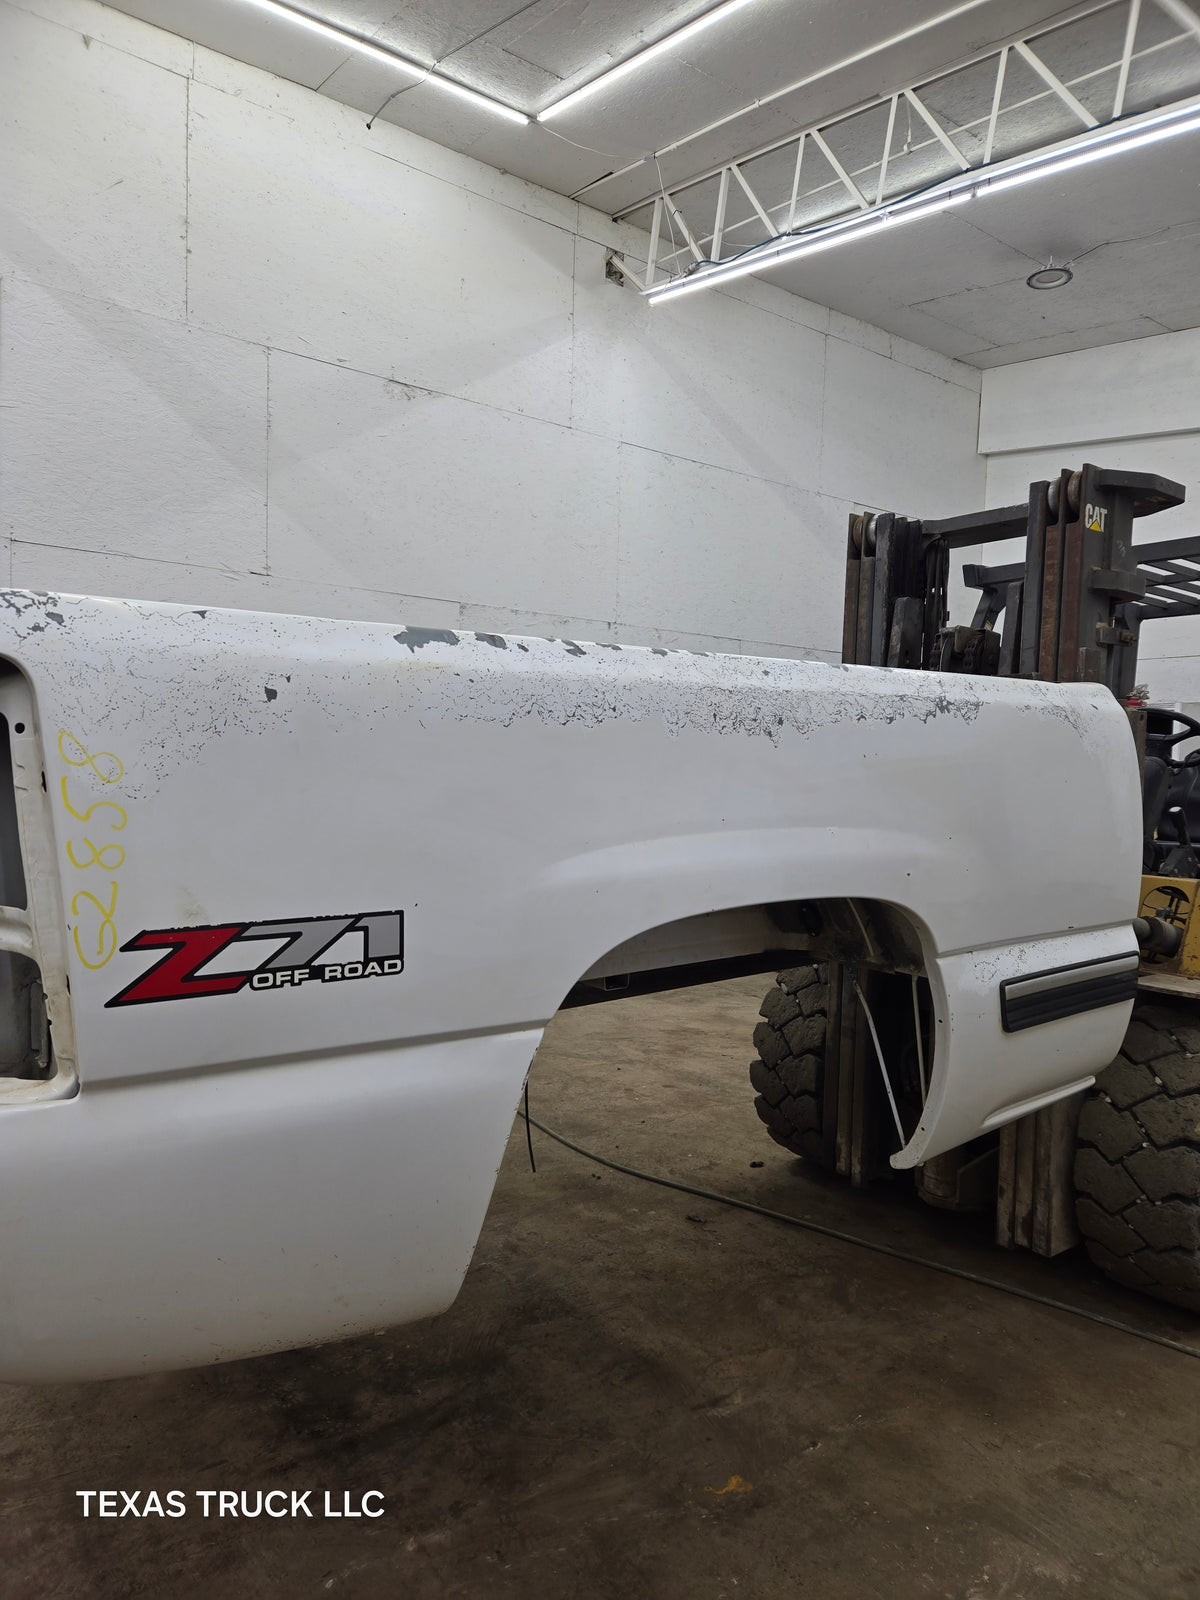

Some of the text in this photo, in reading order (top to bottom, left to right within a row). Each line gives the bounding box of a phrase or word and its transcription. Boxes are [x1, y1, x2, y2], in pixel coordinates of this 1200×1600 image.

[1085, 503, 1108, 533] CAT
[104, 910, 404, 1009] Z71
[252, 959, 402, 988] OFF ROAD
